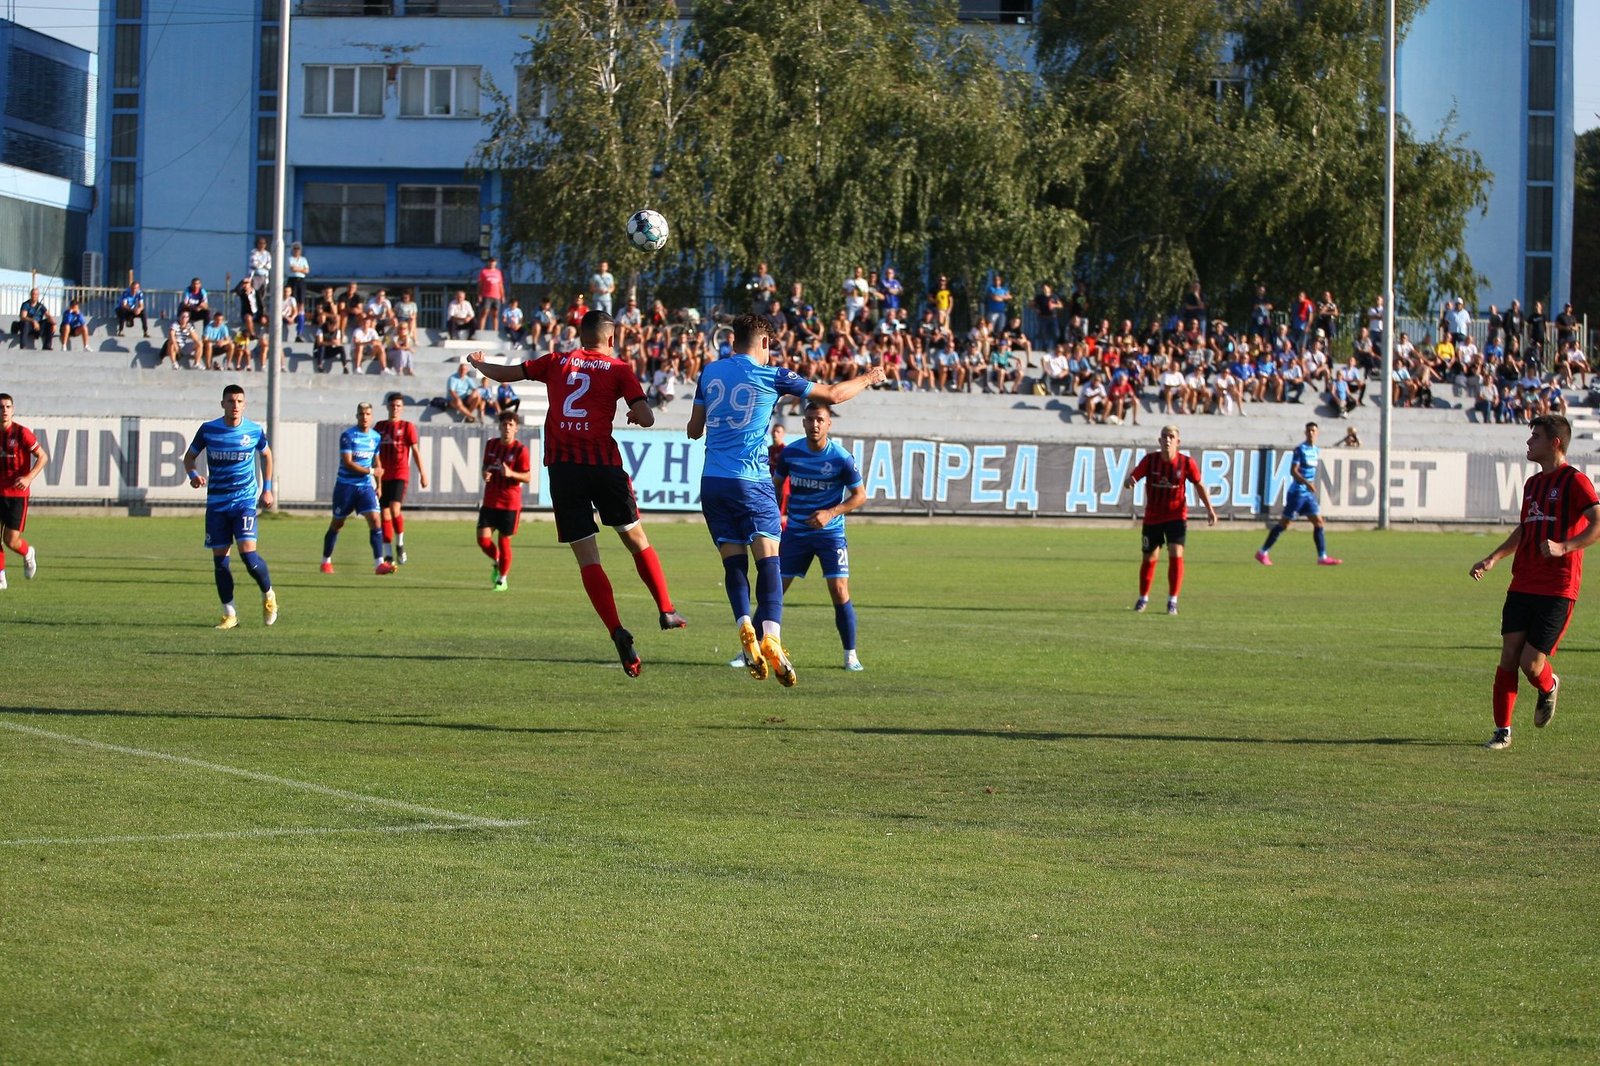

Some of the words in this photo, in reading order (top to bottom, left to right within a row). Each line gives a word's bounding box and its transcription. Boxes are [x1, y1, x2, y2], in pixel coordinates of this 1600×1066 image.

[563, 371, 591, 418] 2
[705, 379, 756, 429] 29
[560, 422, 589, 431] РУСЕ
[210, 451, 251, 461] WINBET
[621, 441, 691, 484] УН
[790, 476, 833, 490] WINBET
[831, 437, 1039, 512] НАПРЕД
[1315, 458, 1437, 508] NBET
[242, 516, 255, 531] 17
[837, 549, 849, 566] 21
